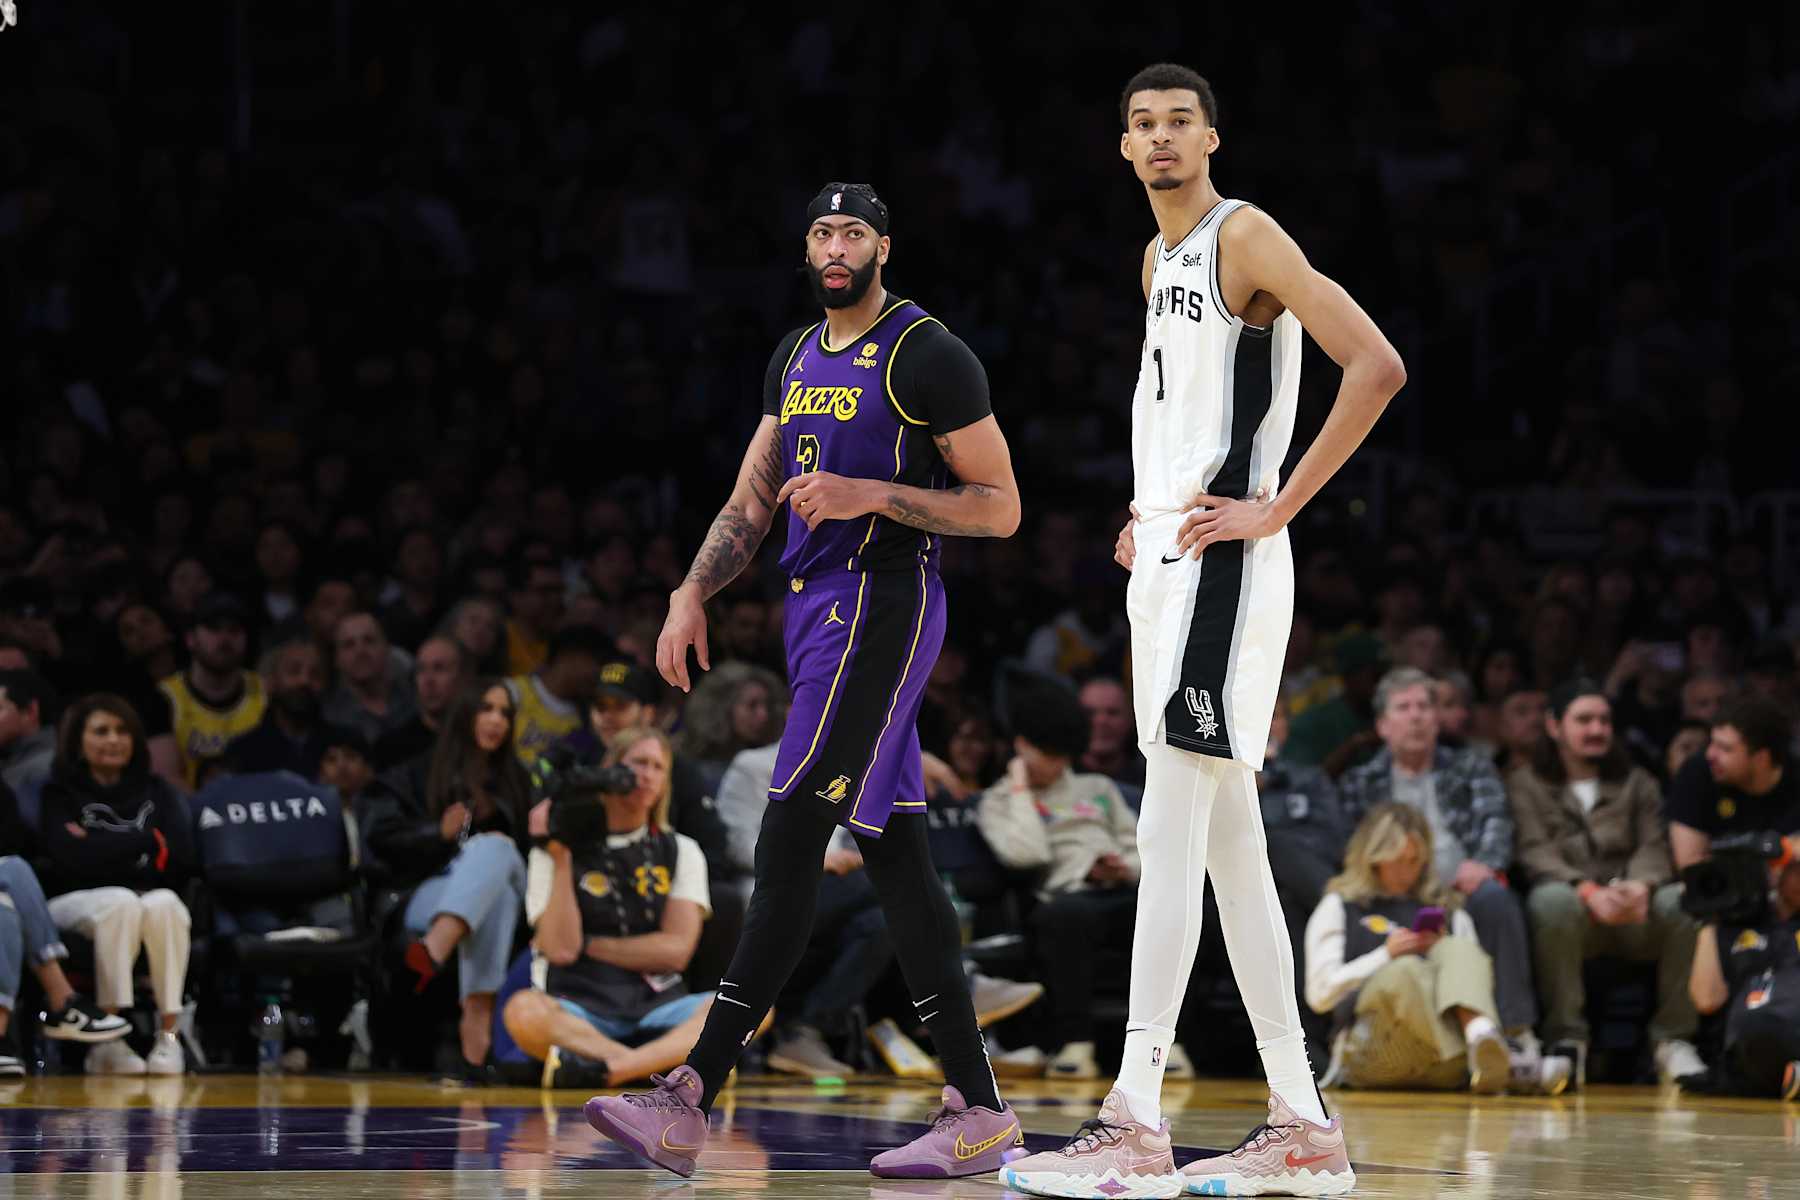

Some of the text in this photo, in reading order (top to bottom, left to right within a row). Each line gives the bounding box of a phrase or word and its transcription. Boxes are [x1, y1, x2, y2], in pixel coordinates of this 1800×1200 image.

[1182, 253, 1202, 267] Self.
[853, 357, 877, 368] bibigo
[1153, 348, 1165, 401] 1
[781, 380, 864, 426] LAKERS
[226, 796, 328, 825] DELTA
